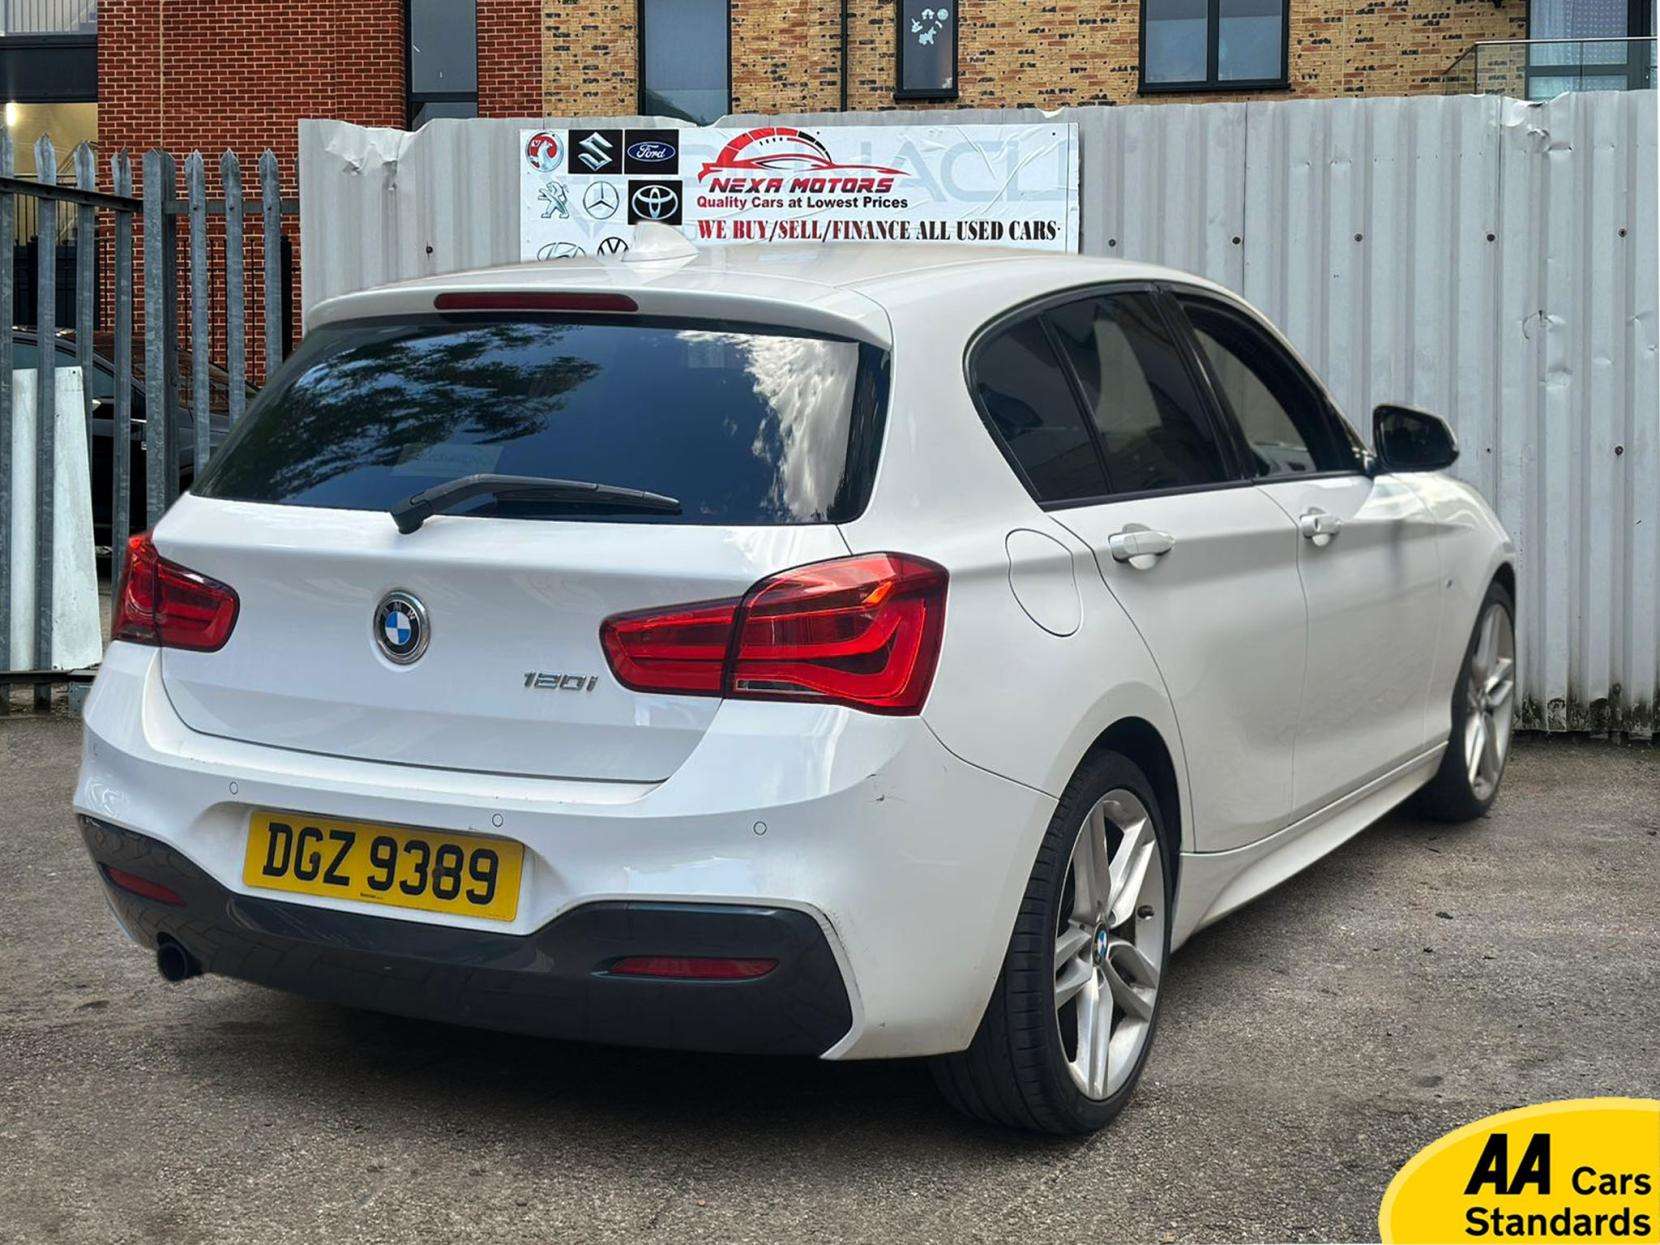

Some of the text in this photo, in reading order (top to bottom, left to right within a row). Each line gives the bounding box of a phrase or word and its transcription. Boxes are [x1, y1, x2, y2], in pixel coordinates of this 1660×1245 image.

[636, 143, 666, 159] Ford
[708, 177, 895, 194] NEXA MOTORS
[697, 195, 909, 211] Quality Cars at Lowest Prices
[697, 219, 1057, 243] WE BUY/SELL/FINANCE ALL USED CARS
[262, 821, 500, 905] DGZ 9389
